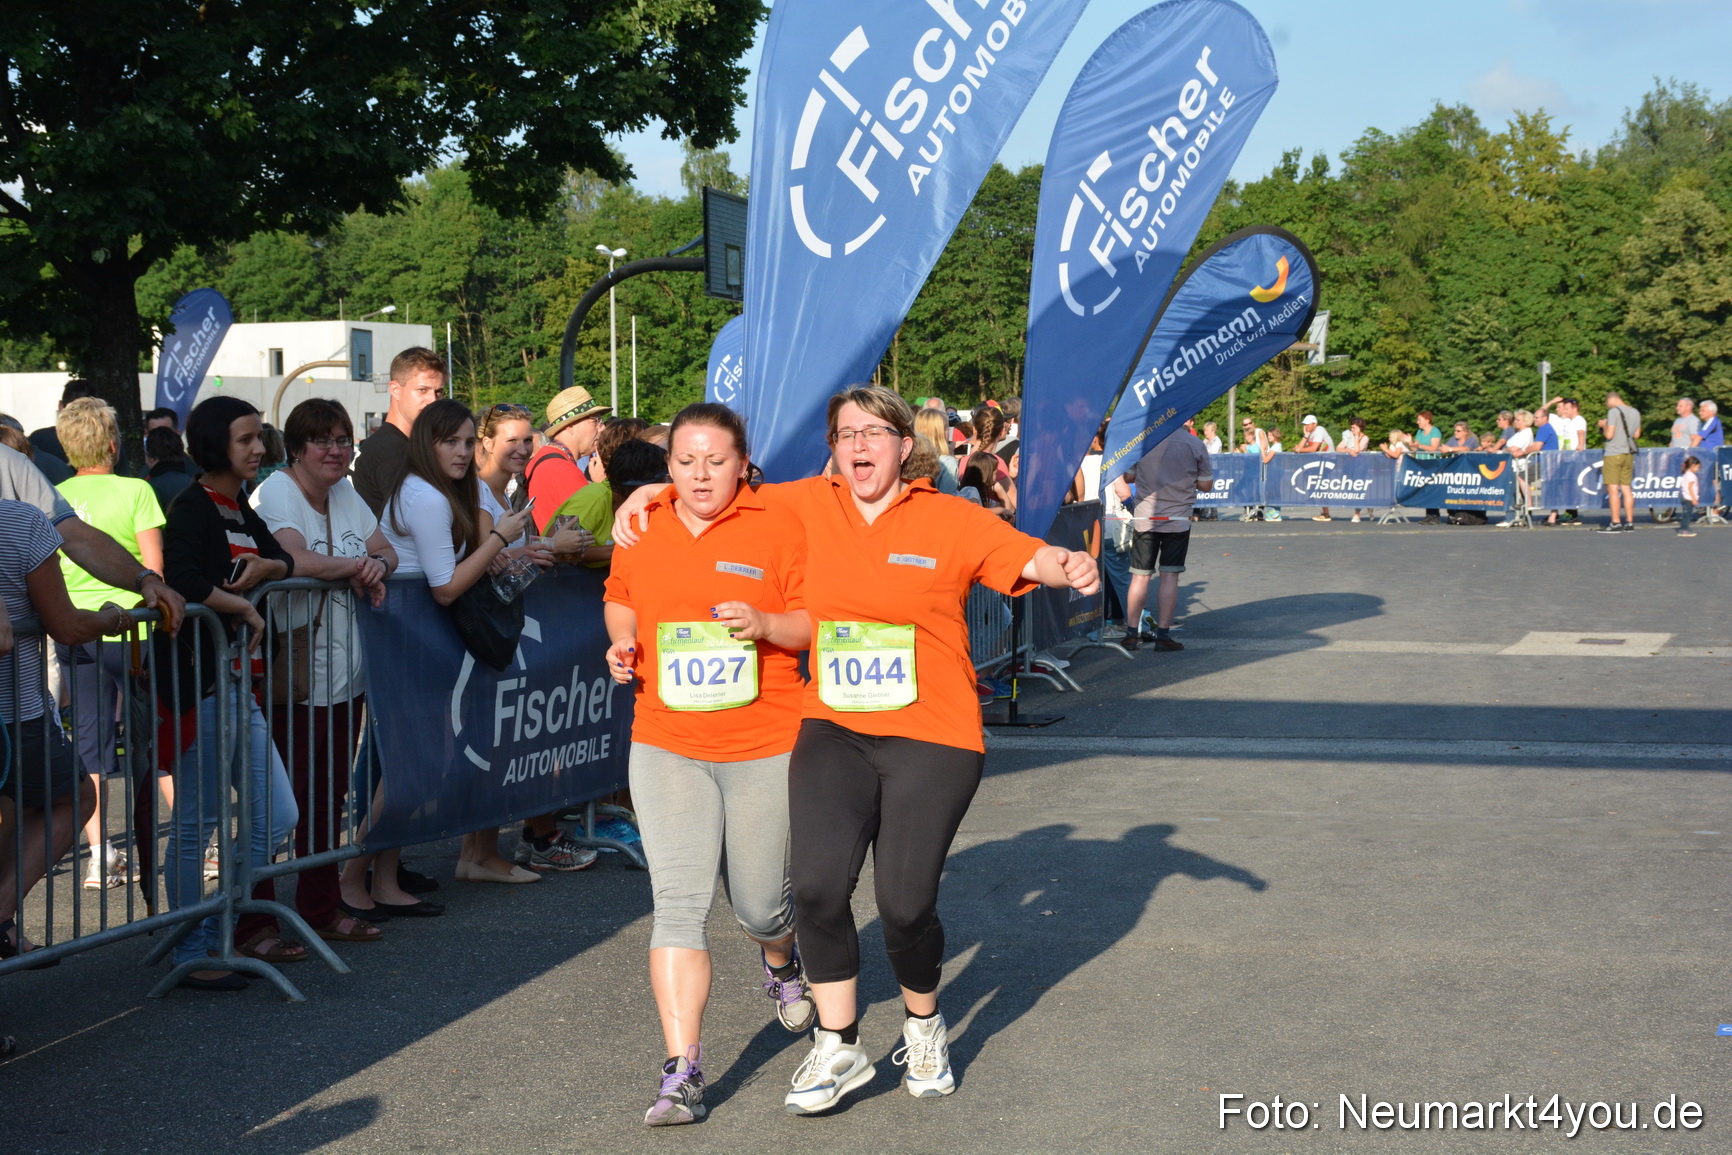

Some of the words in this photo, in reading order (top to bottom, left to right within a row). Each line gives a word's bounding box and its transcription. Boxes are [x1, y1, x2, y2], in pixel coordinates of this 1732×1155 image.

[908, 0, 1034, 197] AUTOMOB
[1089, 45, 1219, 278] Fischer
[1134, 86, 1236, 274] AUTOMOBILE
[174, 306, 216, 388] Fischer
[187, 321, 221, 386] AUTOMOBILE
[1133, 307, 1262, 407] Frischmann
[1214, 336, 1247, 366] Druck
[1268, 295, 1308, 330] Medien
[1196, 491, 1229, 500] MOBILE
[1306, 475, 1372, 491] Fischer
[1309, 491, 1366, 500] AUTOMOBILE
[1631, 472, 1684, 489] cher
[668, 656, 747, 686] 1027
[828, 656, 906, 686] 1044
[493, 665, 620, 748] Fischer
[502, 733, 612, 787] AUTOMOBILE
